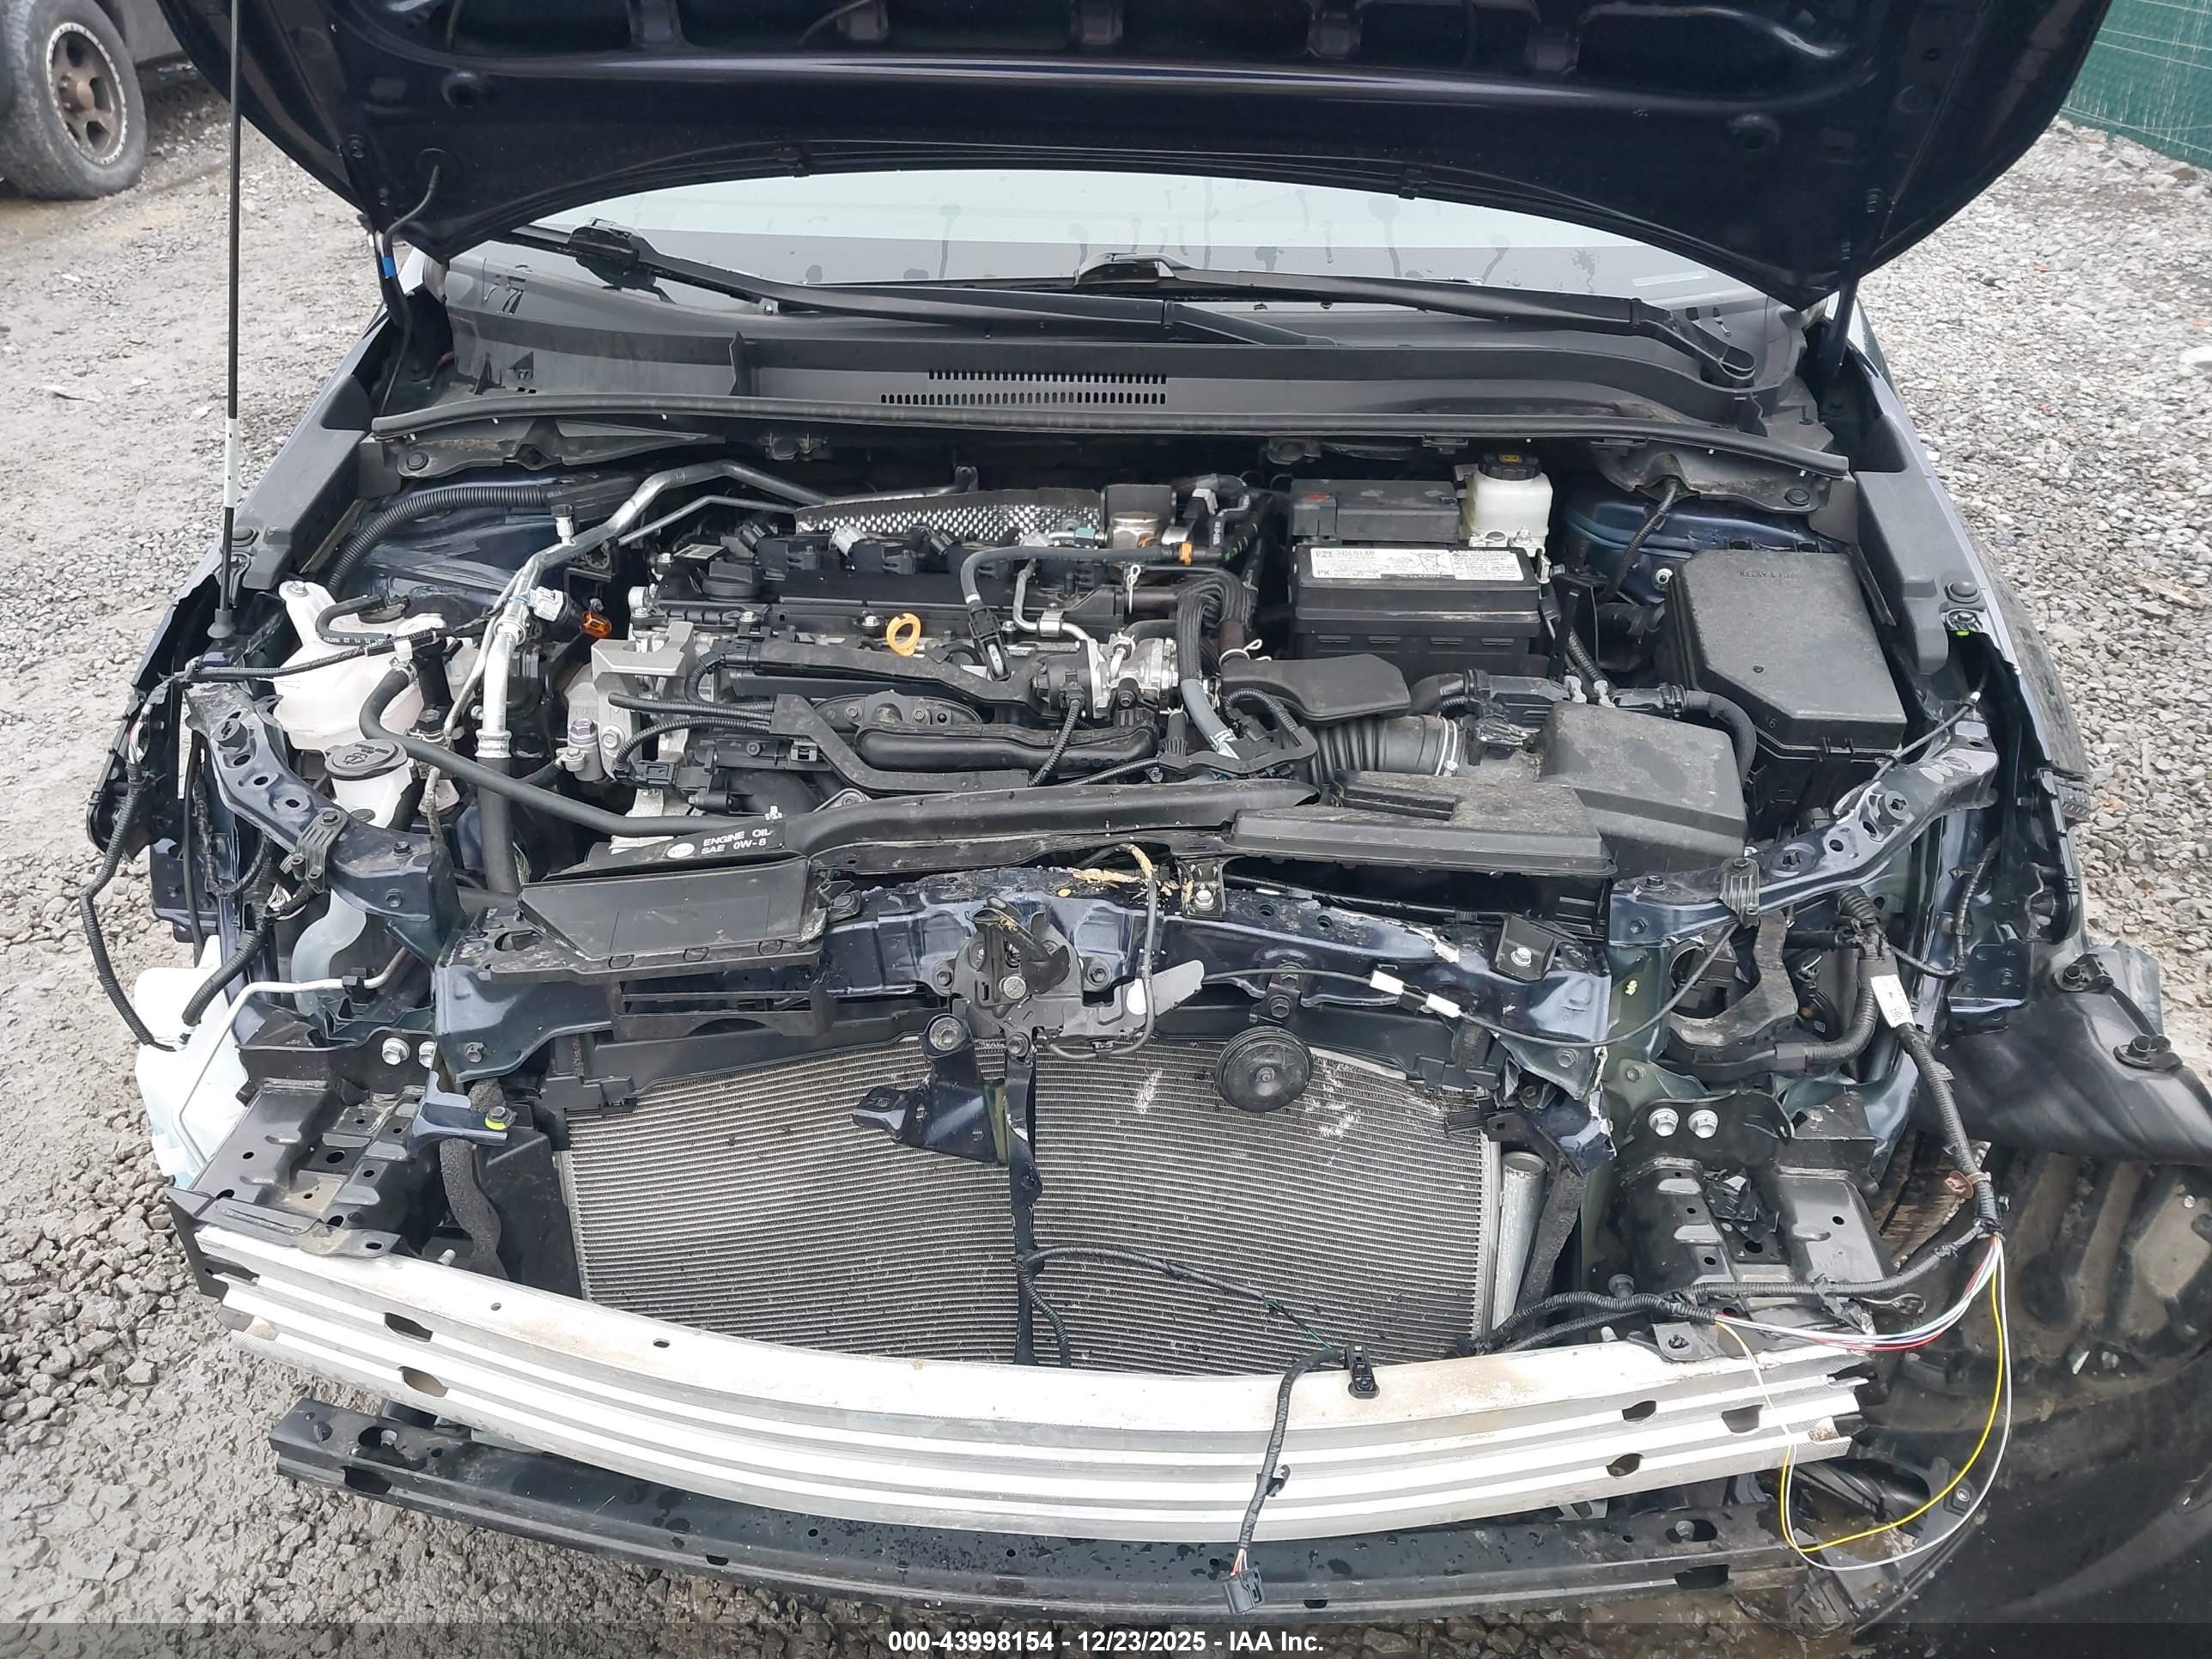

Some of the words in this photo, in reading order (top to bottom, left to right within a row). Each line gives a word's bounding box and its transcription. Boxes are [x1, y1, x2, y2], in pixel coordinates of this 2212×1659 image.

[701, 844, 726, 855] SAE
[732, 837, 767, 850] 0W-8
[702, 830, 745, 847] ENGINE
[751, 828, 771, 838] OIL
